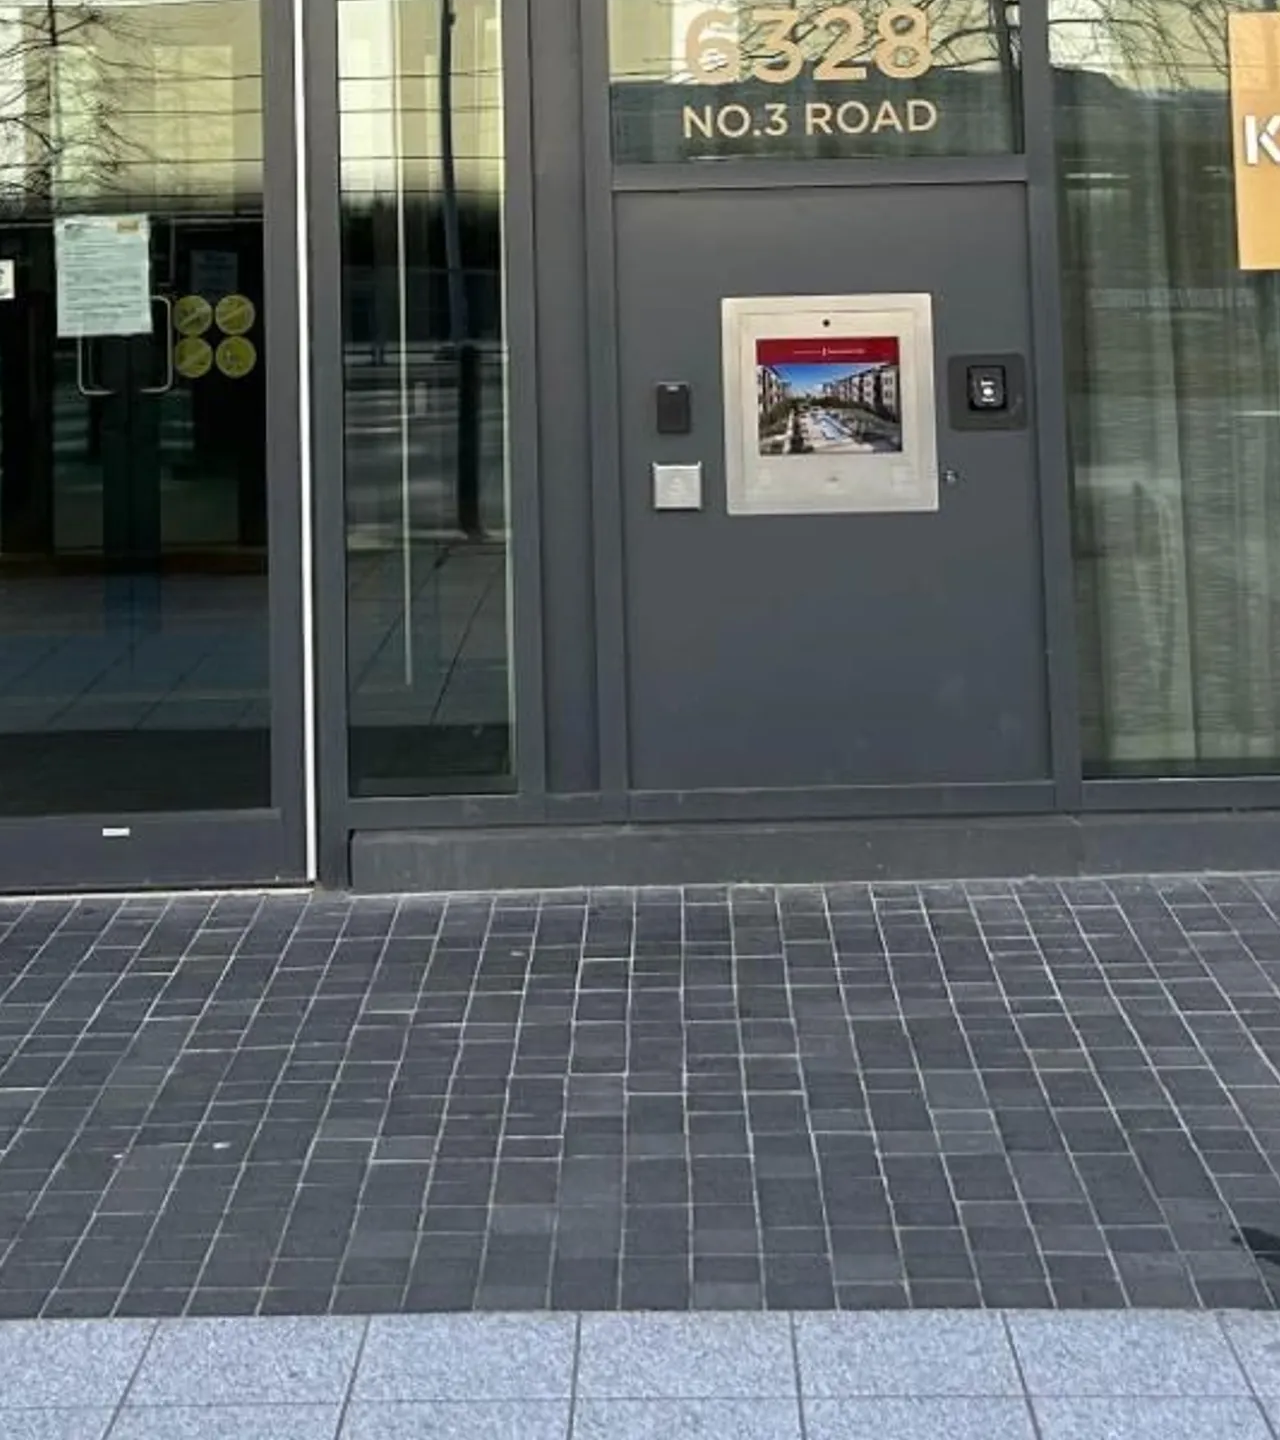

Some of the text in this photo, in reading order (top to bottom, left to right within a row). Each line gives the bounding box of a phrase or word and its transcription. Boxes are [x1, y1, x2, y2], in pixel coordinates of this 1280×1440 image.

[684, 6, 933, 85] 6328
[683, 99, 937, 138] NO.3 ROAD
